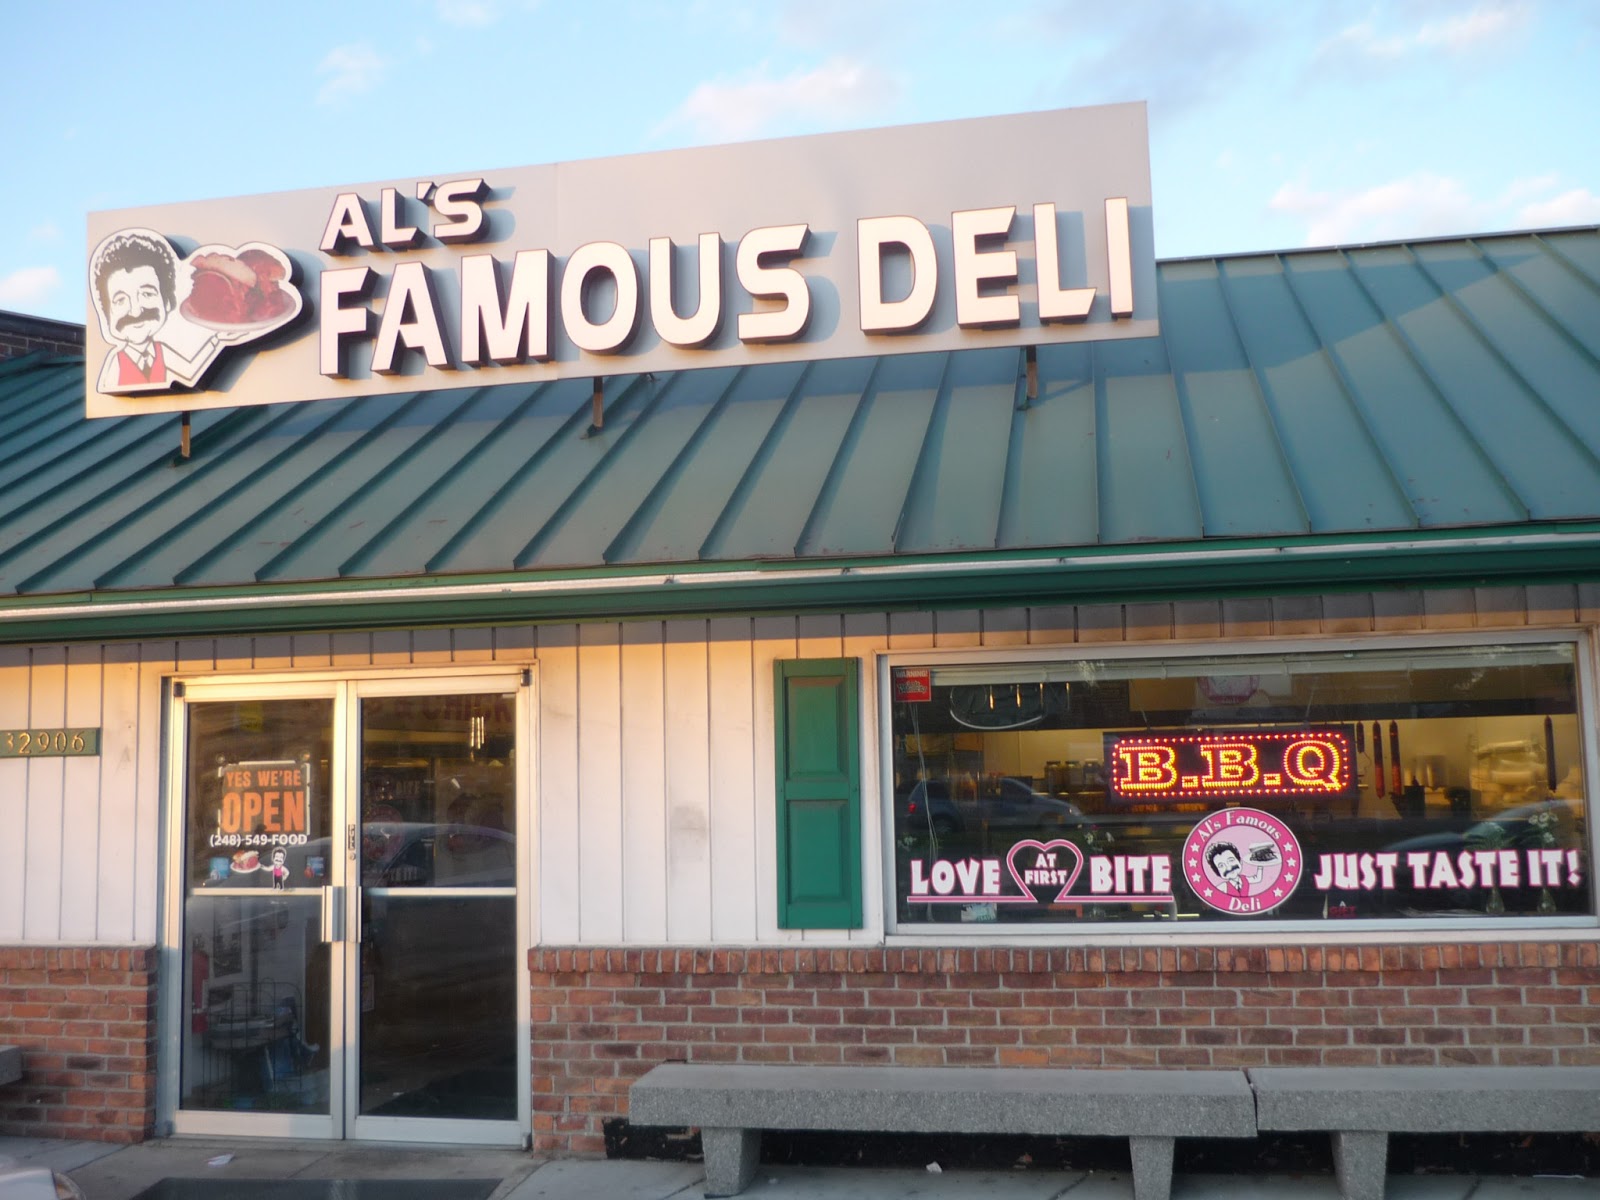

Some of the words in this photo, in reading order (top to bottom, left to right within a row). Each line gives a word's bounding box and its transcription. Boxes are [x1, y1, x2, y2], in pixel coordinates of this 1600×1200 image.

[318, 178, 487, 252] AL'S
[319, 223, 812, 377] FAMOUS
[857, 197, 1134, 335] DELI
[6, 732, 86, 754] 32906
[226, 771, 252, 787] YES
[257, 769, 302, 786] WE'RE
[222, 791, 305, 833] OPEN
[1198, 819, 1222, 842] Al's
[1225, 811, 1282, 840] Famous
[210, 834, 241, 847] (248)
[245, 834, 308, 846] 549-FOOD
[1035, 853, 1057, 868] AT
[1090, 855, 1171, 894] BITE
[1314, 853, 1398, 890] JUST
[1407, 850, 1520, 889] TASTE
[1527, 849, 1582, 888] IT!
[910, 857, 1001, 896] LOVE
[1024, 869, 1067, 885] FIRST
[1228, 897, 1261, 912] Deli
